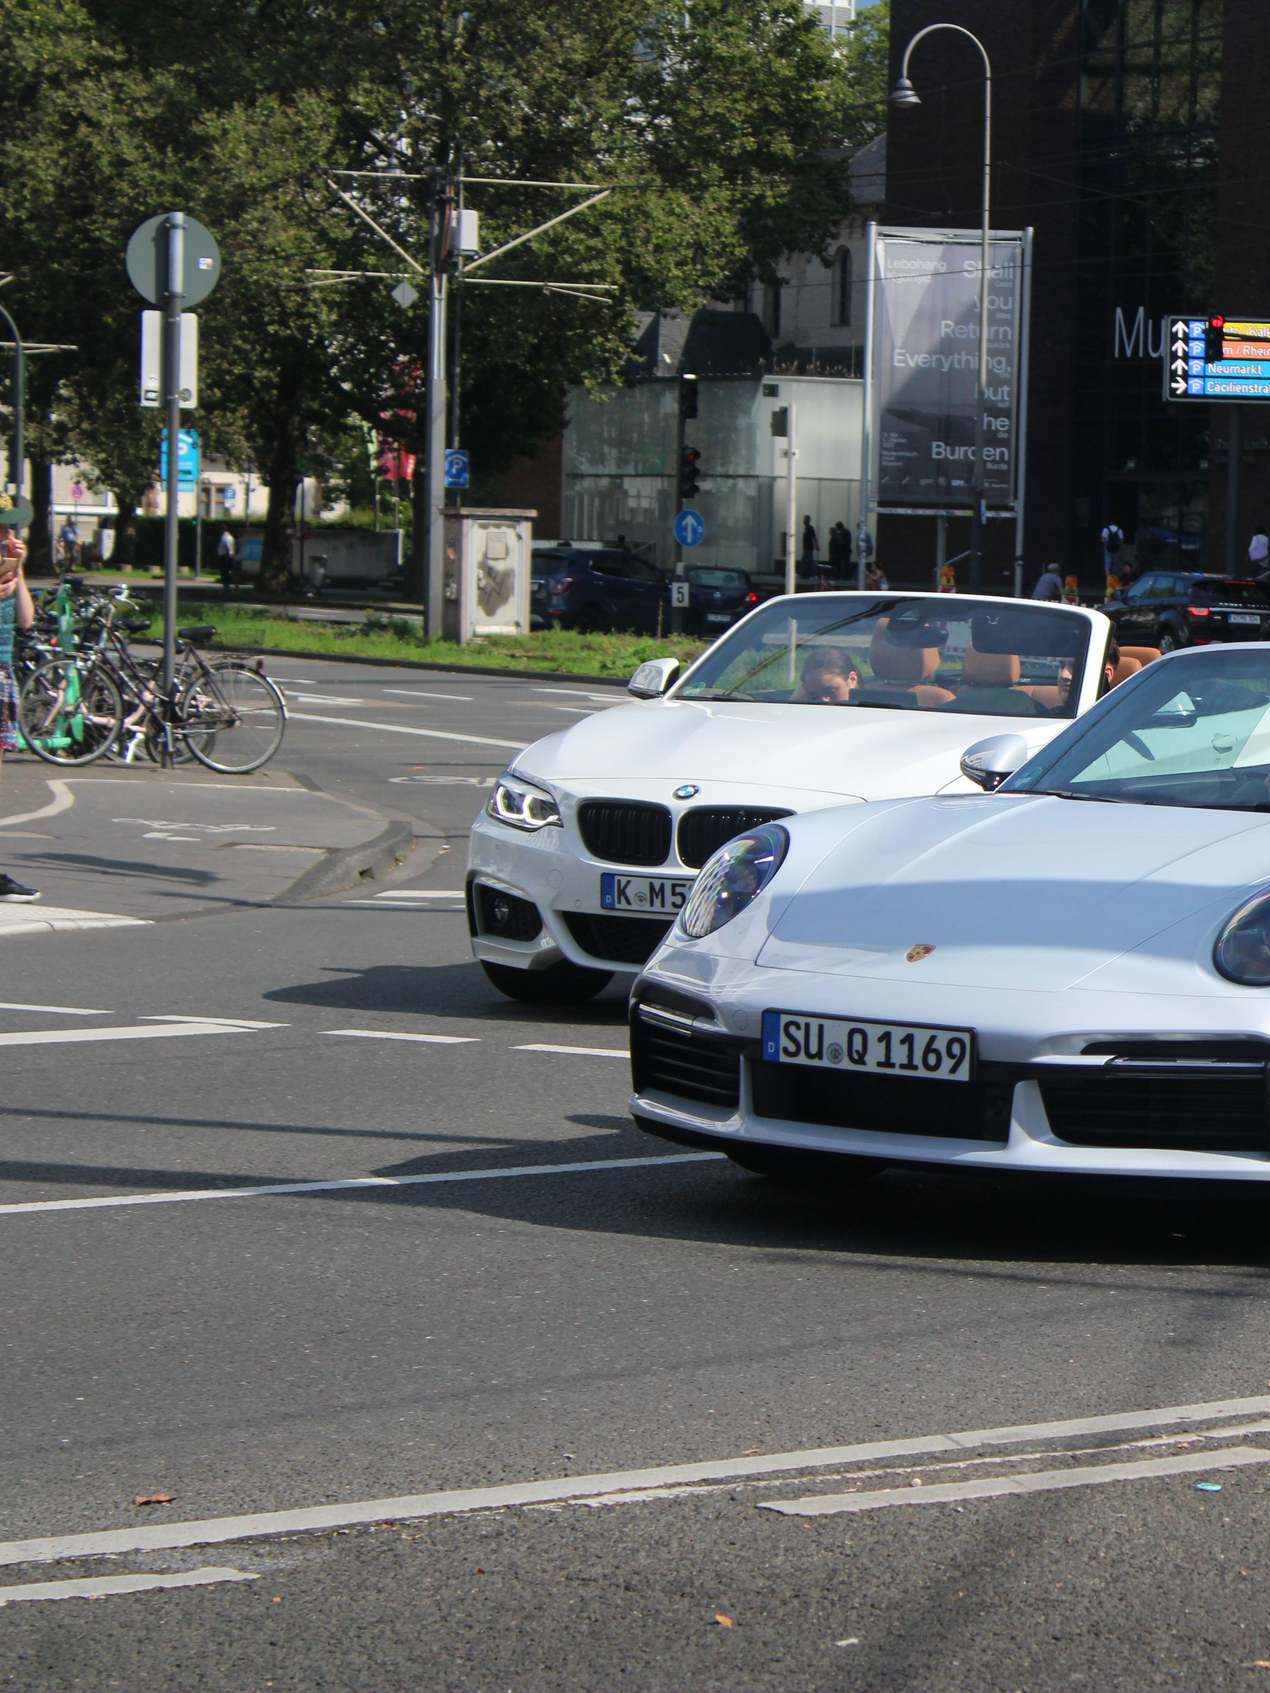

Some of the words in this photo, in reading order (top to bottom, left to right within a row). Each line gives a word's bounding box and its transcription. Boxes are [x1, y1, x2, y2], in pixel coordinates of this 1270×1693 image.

[887, 258, 947, 272] Lebohang
[1208, 362, 1263, 375] Neumarkt
[676, 586, 684, 603] 5
[616, 879, 632, 906] K
[649, 881, 665, 908] M
[671, 883, 692, 909] 5
[782, 1020, 824, 1061] SU
[847, 1027, 868, 1066] Q
[876, 1031, 967, 1075] 1169
